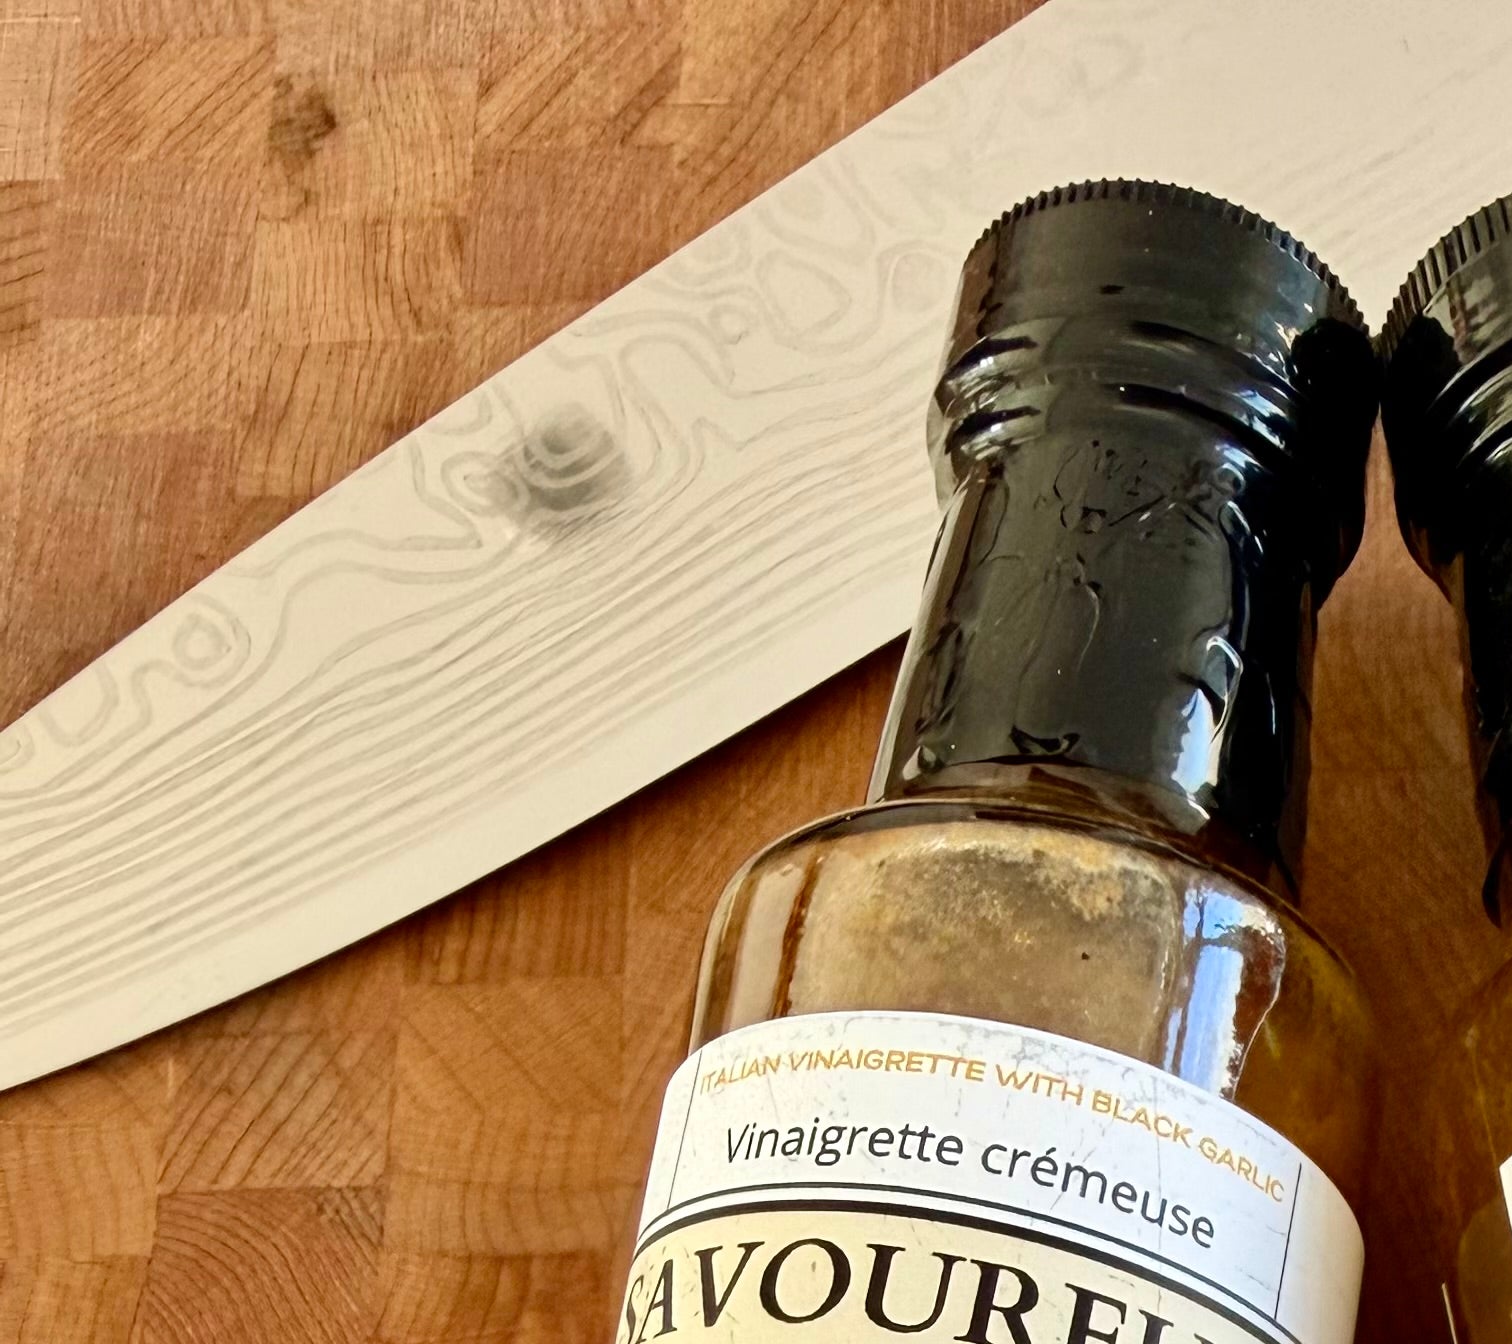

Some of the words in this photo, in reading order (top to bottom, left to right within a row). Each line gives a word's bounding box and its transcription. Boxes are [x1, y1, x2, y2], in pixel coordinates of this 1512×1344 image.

[699, 1056, 781, 1095] ITALIAN
[790, 1049, 985, 1082] VINAIGRETTE
[996, 1063, 1082, 1105] WITH
[1091, 1090, 1193, 1150] BLACK
[1197, 1134, 1286, 1204] GARLIC
[726, 1116, 964, 1168] Vinaigrette
[981, 1137, 1216, 1249] crémeuse
